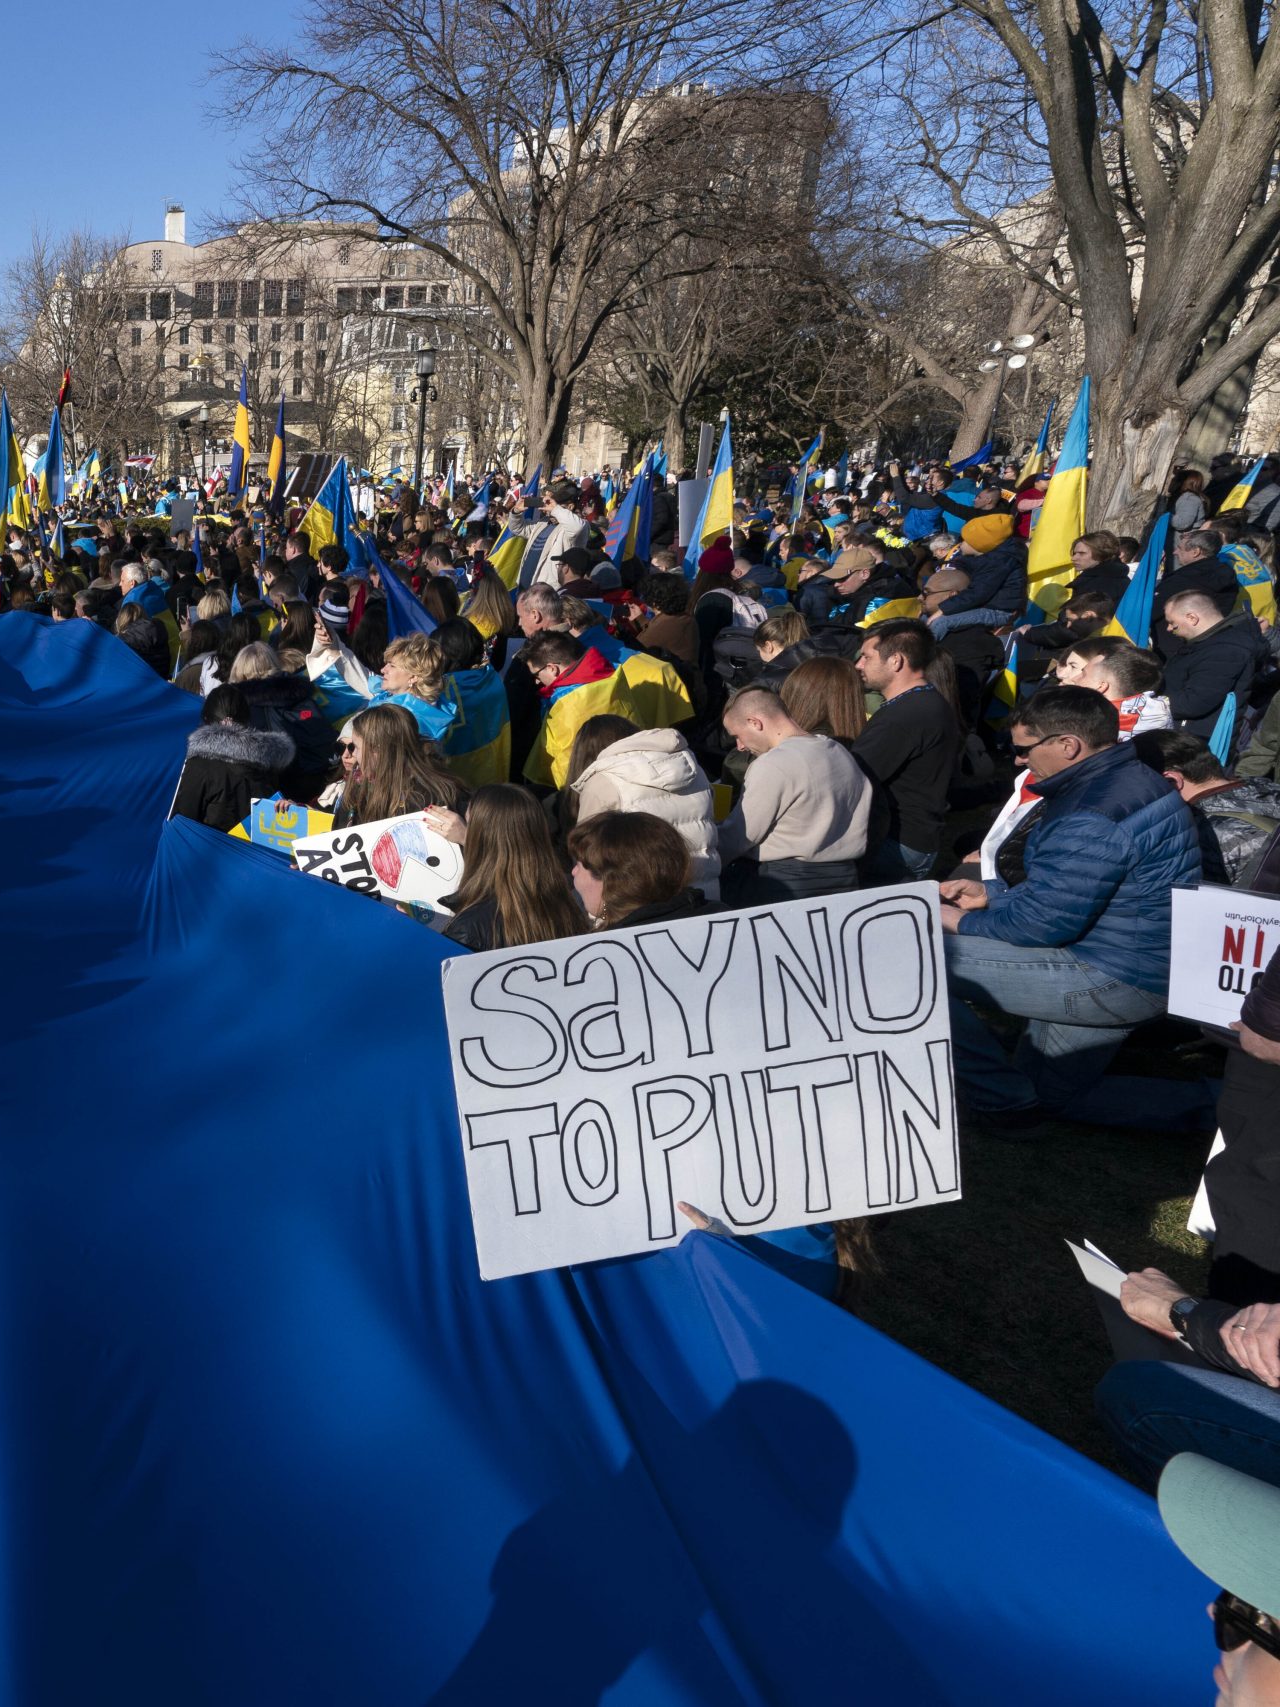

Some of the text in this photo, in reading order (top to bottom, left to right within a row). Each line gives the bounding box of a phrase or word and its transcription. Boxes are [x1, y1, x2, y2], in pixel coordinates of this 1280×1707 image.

[750, 895, 937, 1052] NO
[1225, 912, 1280, 927] ayNOtoPutin
[465, 1038, 959, 1242] TO PUTIN
